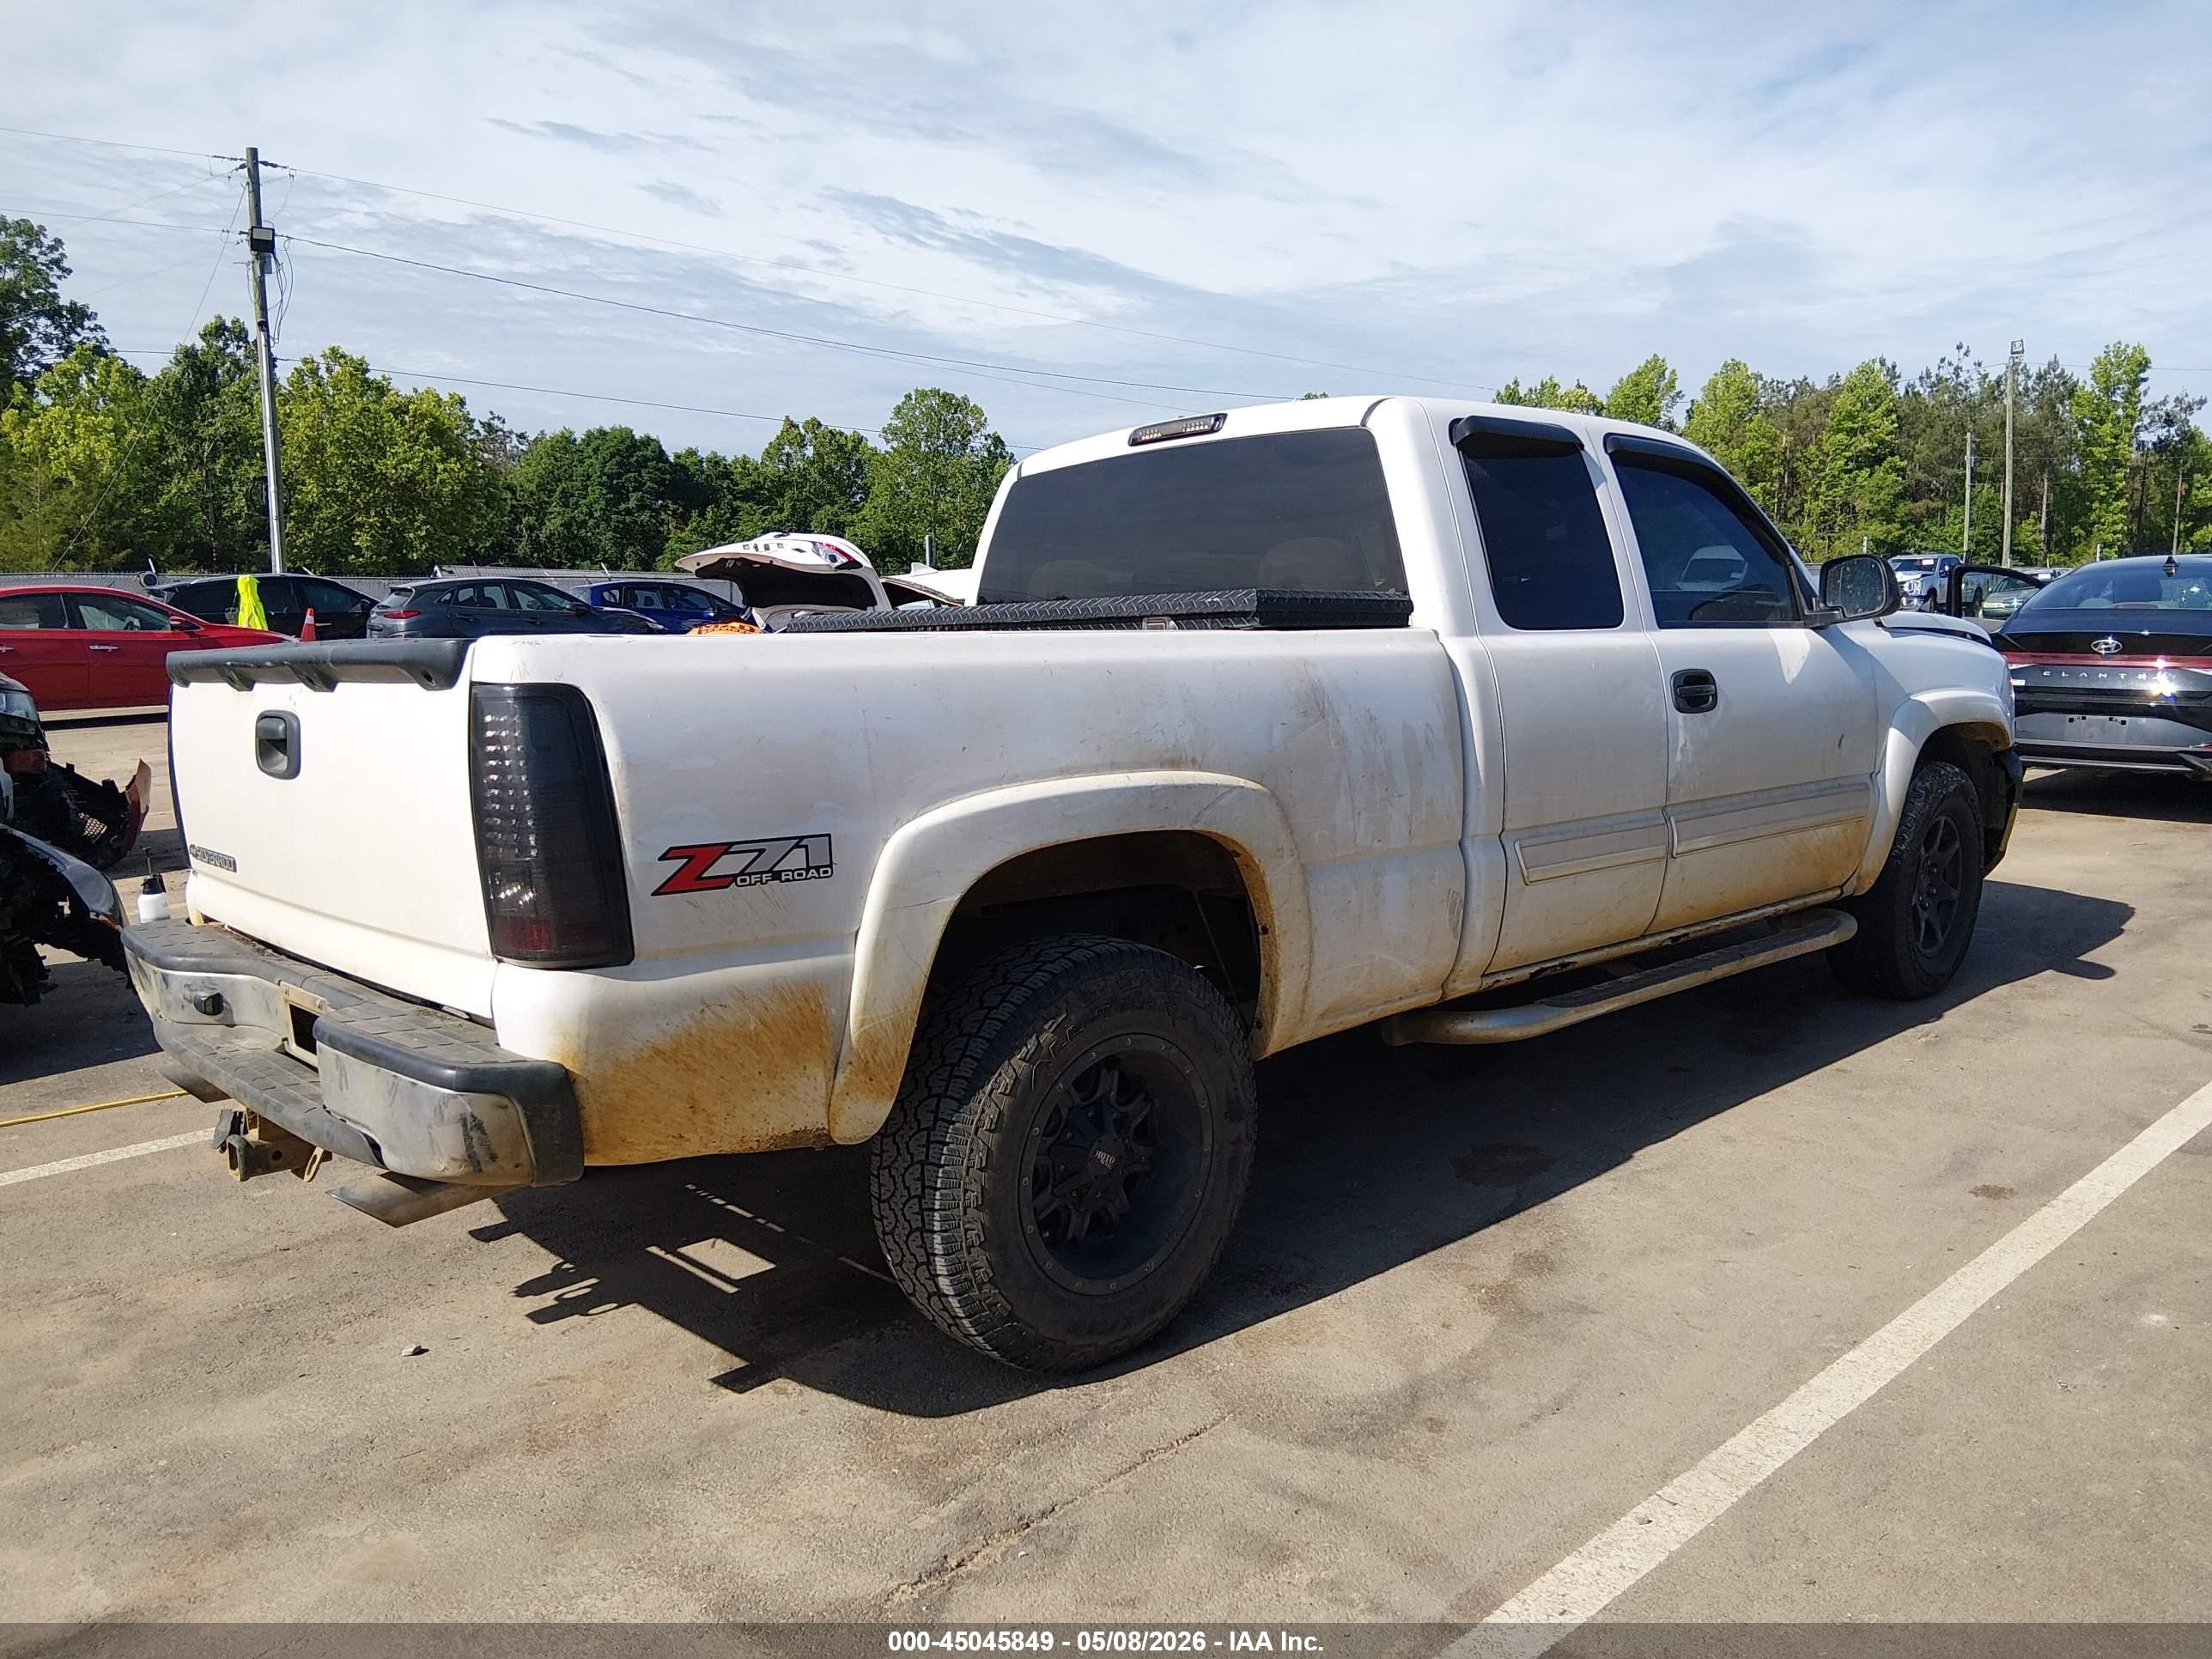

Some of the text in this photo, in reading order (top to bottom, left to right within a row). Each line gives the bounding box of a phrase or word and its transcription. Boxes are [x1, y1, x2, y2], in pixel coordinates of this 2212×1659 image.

[2042, 671, 2160, 680] ELANTR
[194, 847, 235, 872] SILVERADO
[650, 833, 833, 896] Z71
[736, 867, 832, 887] OFF ROAD
